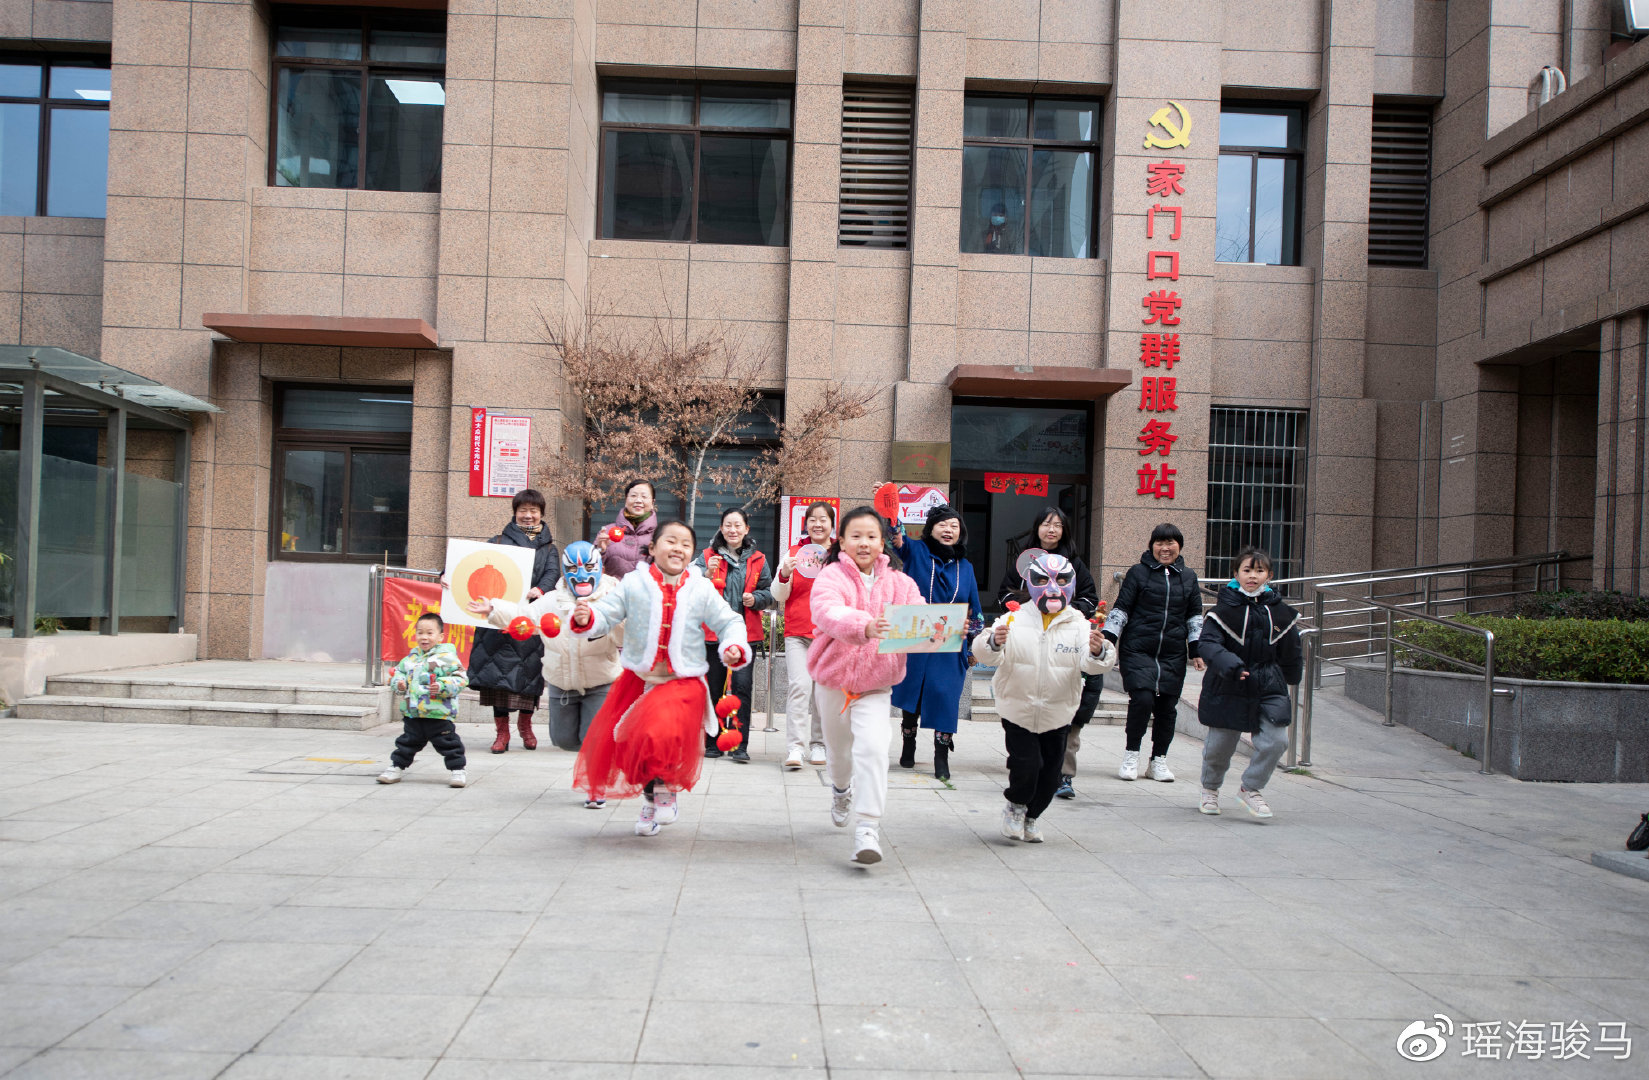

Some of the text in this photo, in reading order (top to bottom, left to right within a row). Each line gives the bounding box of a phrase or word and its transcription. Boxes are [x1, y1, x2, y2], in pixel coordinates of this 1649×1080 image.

[1137, 160, 1186, 499] 家门口党群服务站
[1055, 643, 1081, 653] Pars
